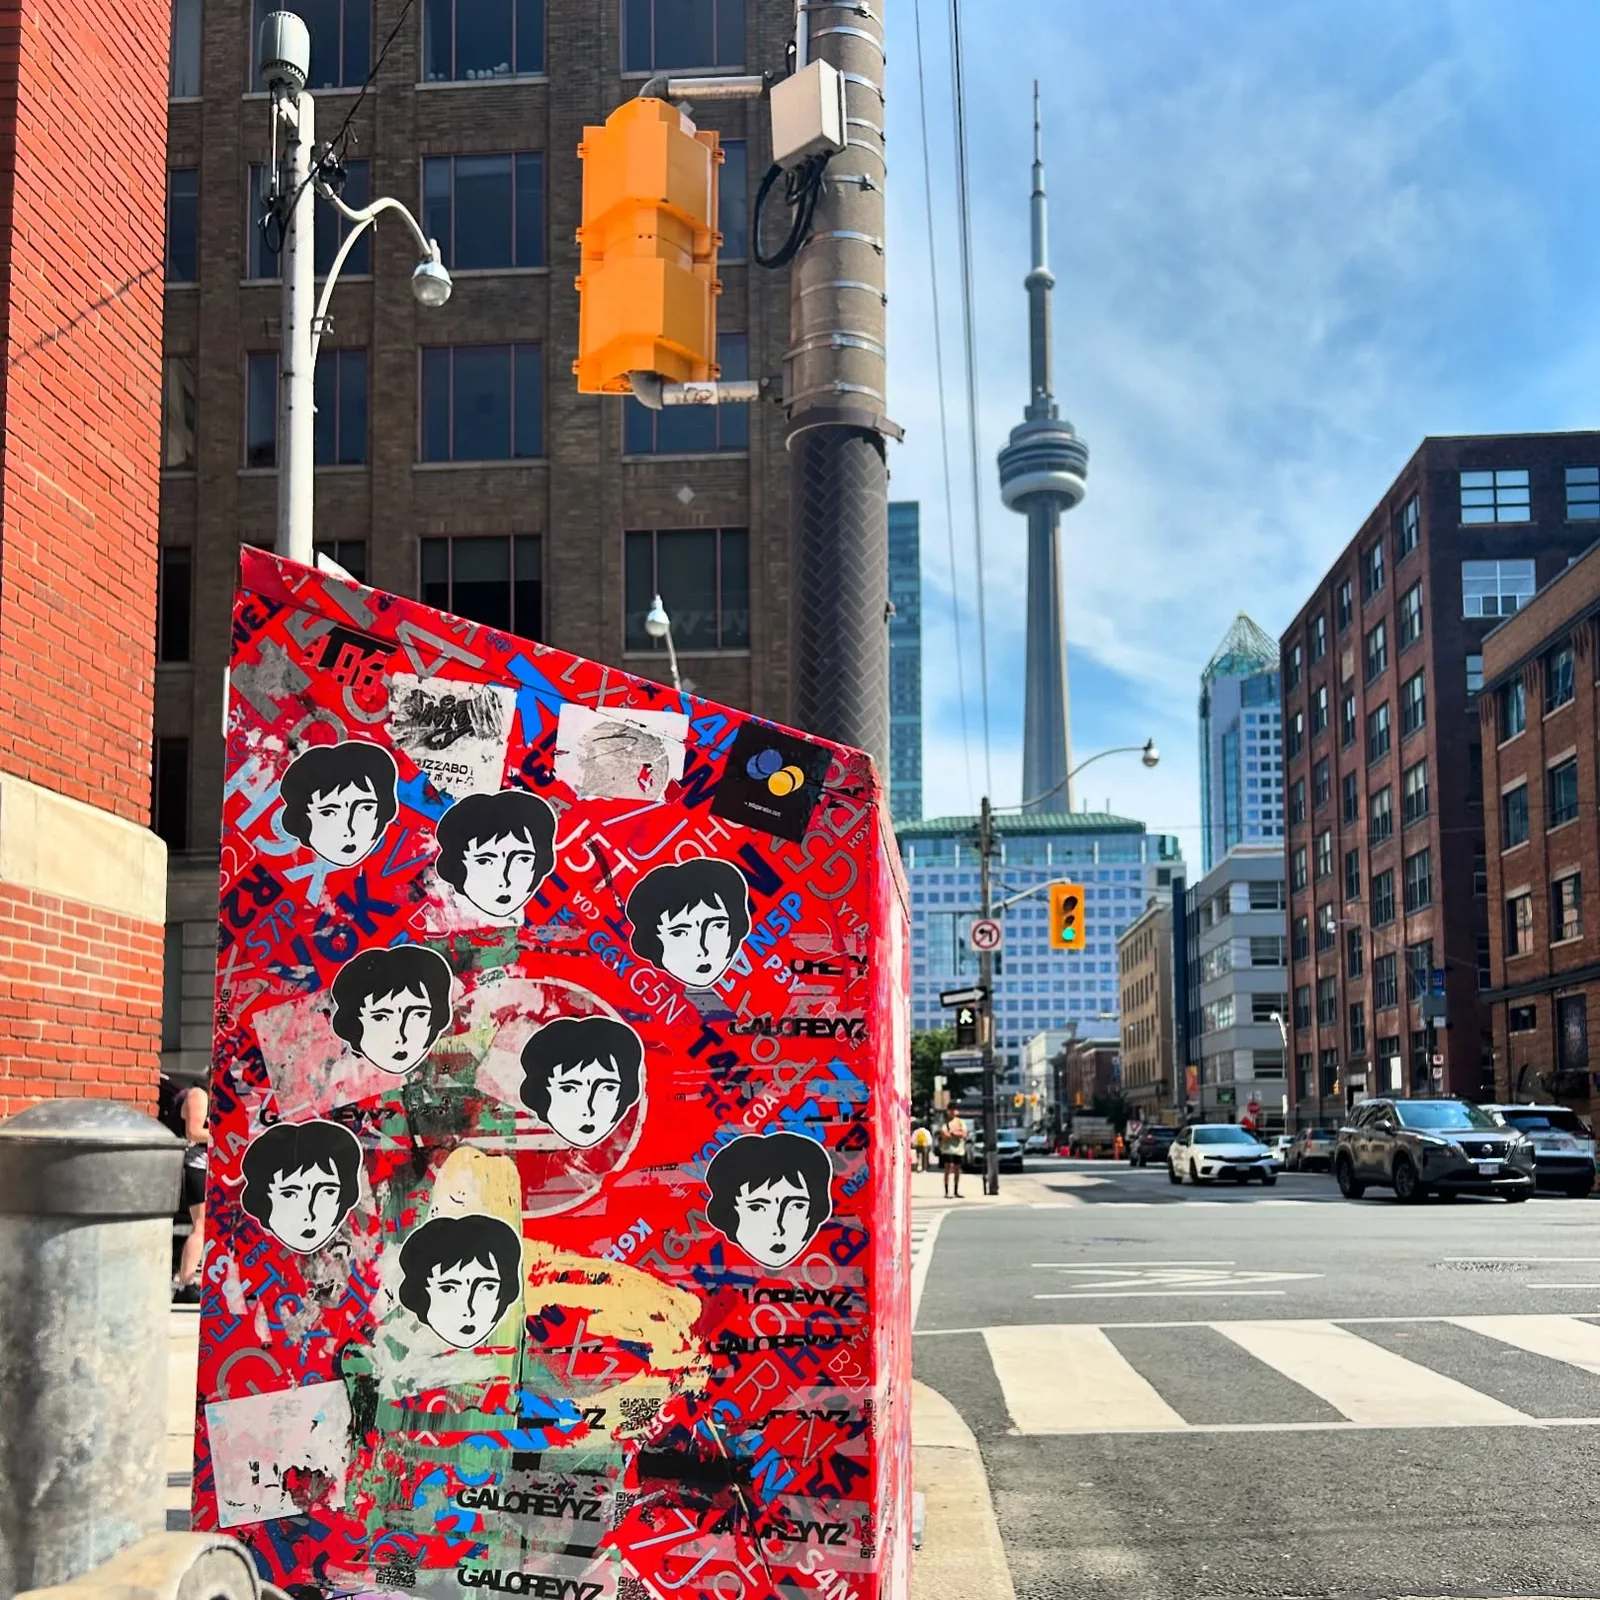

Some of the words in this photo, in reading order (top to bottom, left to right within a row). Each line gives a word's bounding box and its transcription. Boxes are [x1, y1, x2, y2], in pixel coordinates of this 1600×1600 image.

[245, 898, 297, 960] S7P
[745, 889, 804, 957] N5P
[762, 953, 806, 996] P3Y
[629, 966, 688, 1027] G5N
[742, 1092, 780, 1129] C0A
[456, 1487, 602, 1522] GALOREYYZ
[457, 1565, 604, 1600] GALOREYYZ
